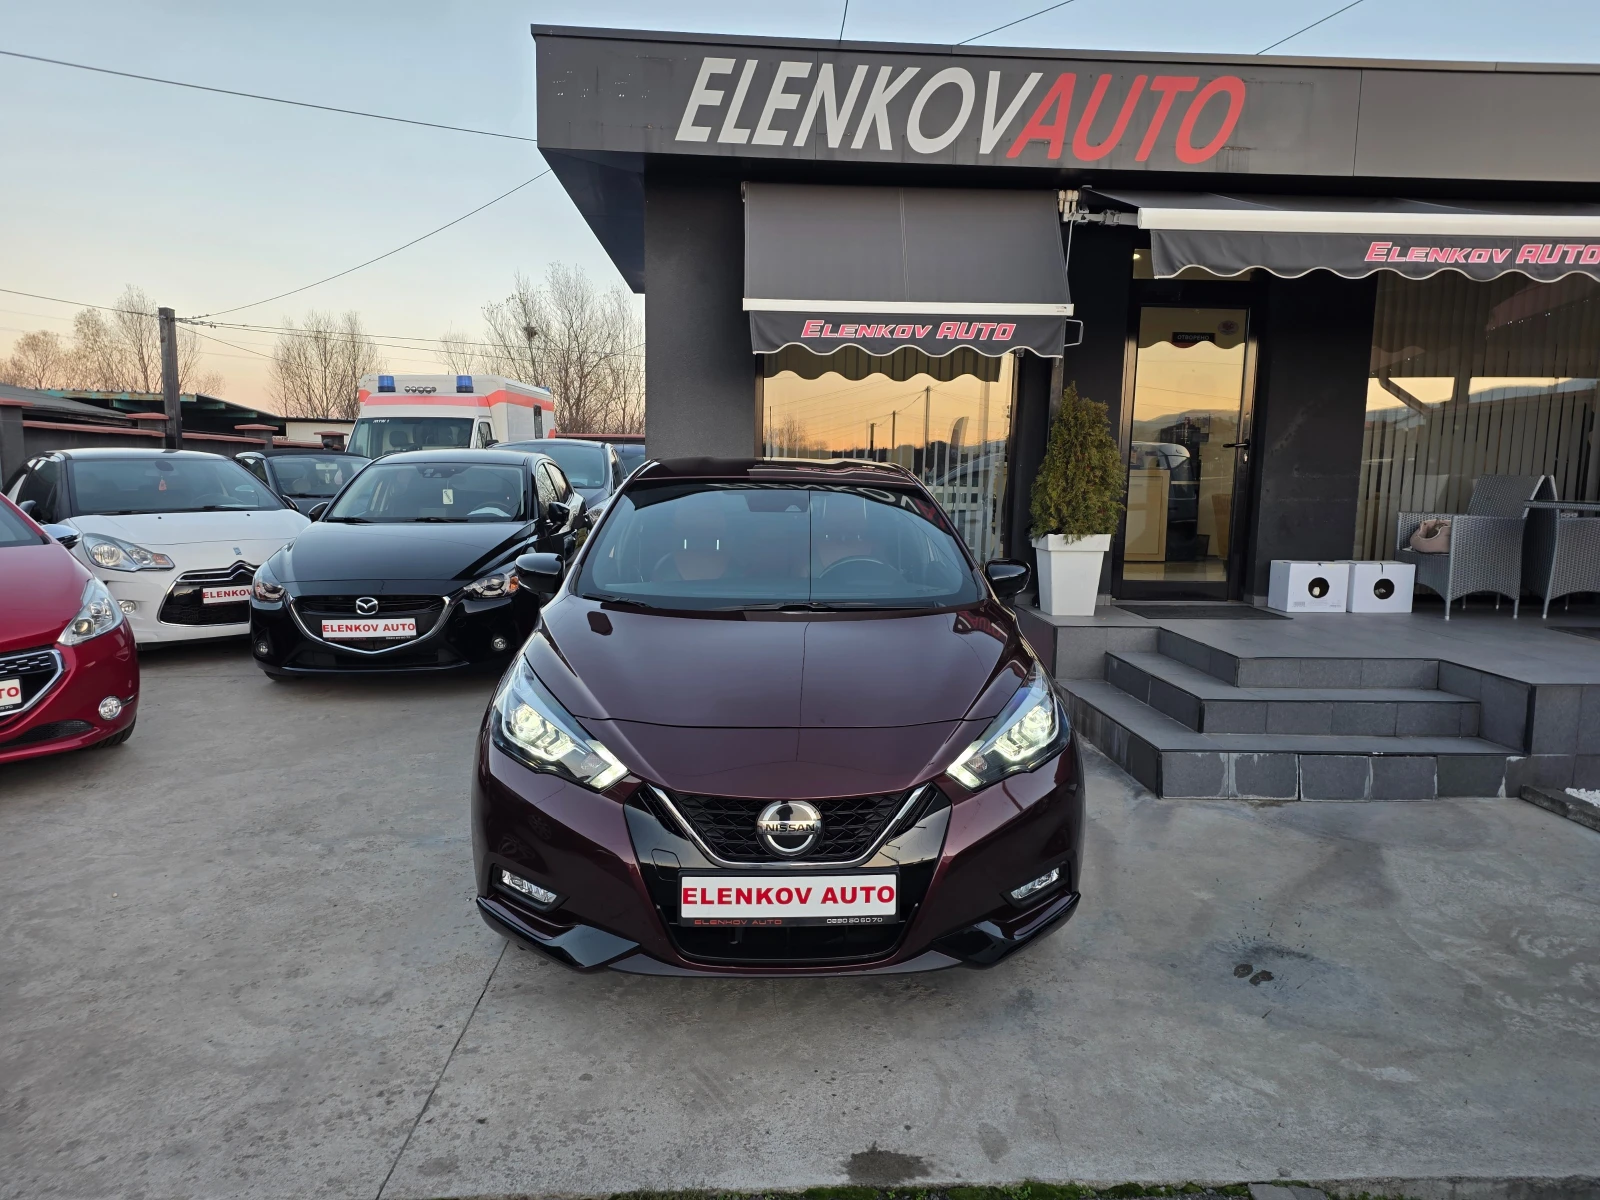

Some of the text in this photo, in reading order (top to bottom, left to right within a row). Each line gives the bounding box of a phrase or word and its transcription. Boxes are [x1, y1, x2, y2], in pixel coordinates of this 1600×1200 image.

[1515, 244, 1600, 264] AUTO
[936, 321, 1016, 340] AUTO
[322, 623, 416, 633] ELENKOV AUTO
[765, 823, 815, 833] NISSAN
[682, 886, 895, 905] ELENKOV AUTO
